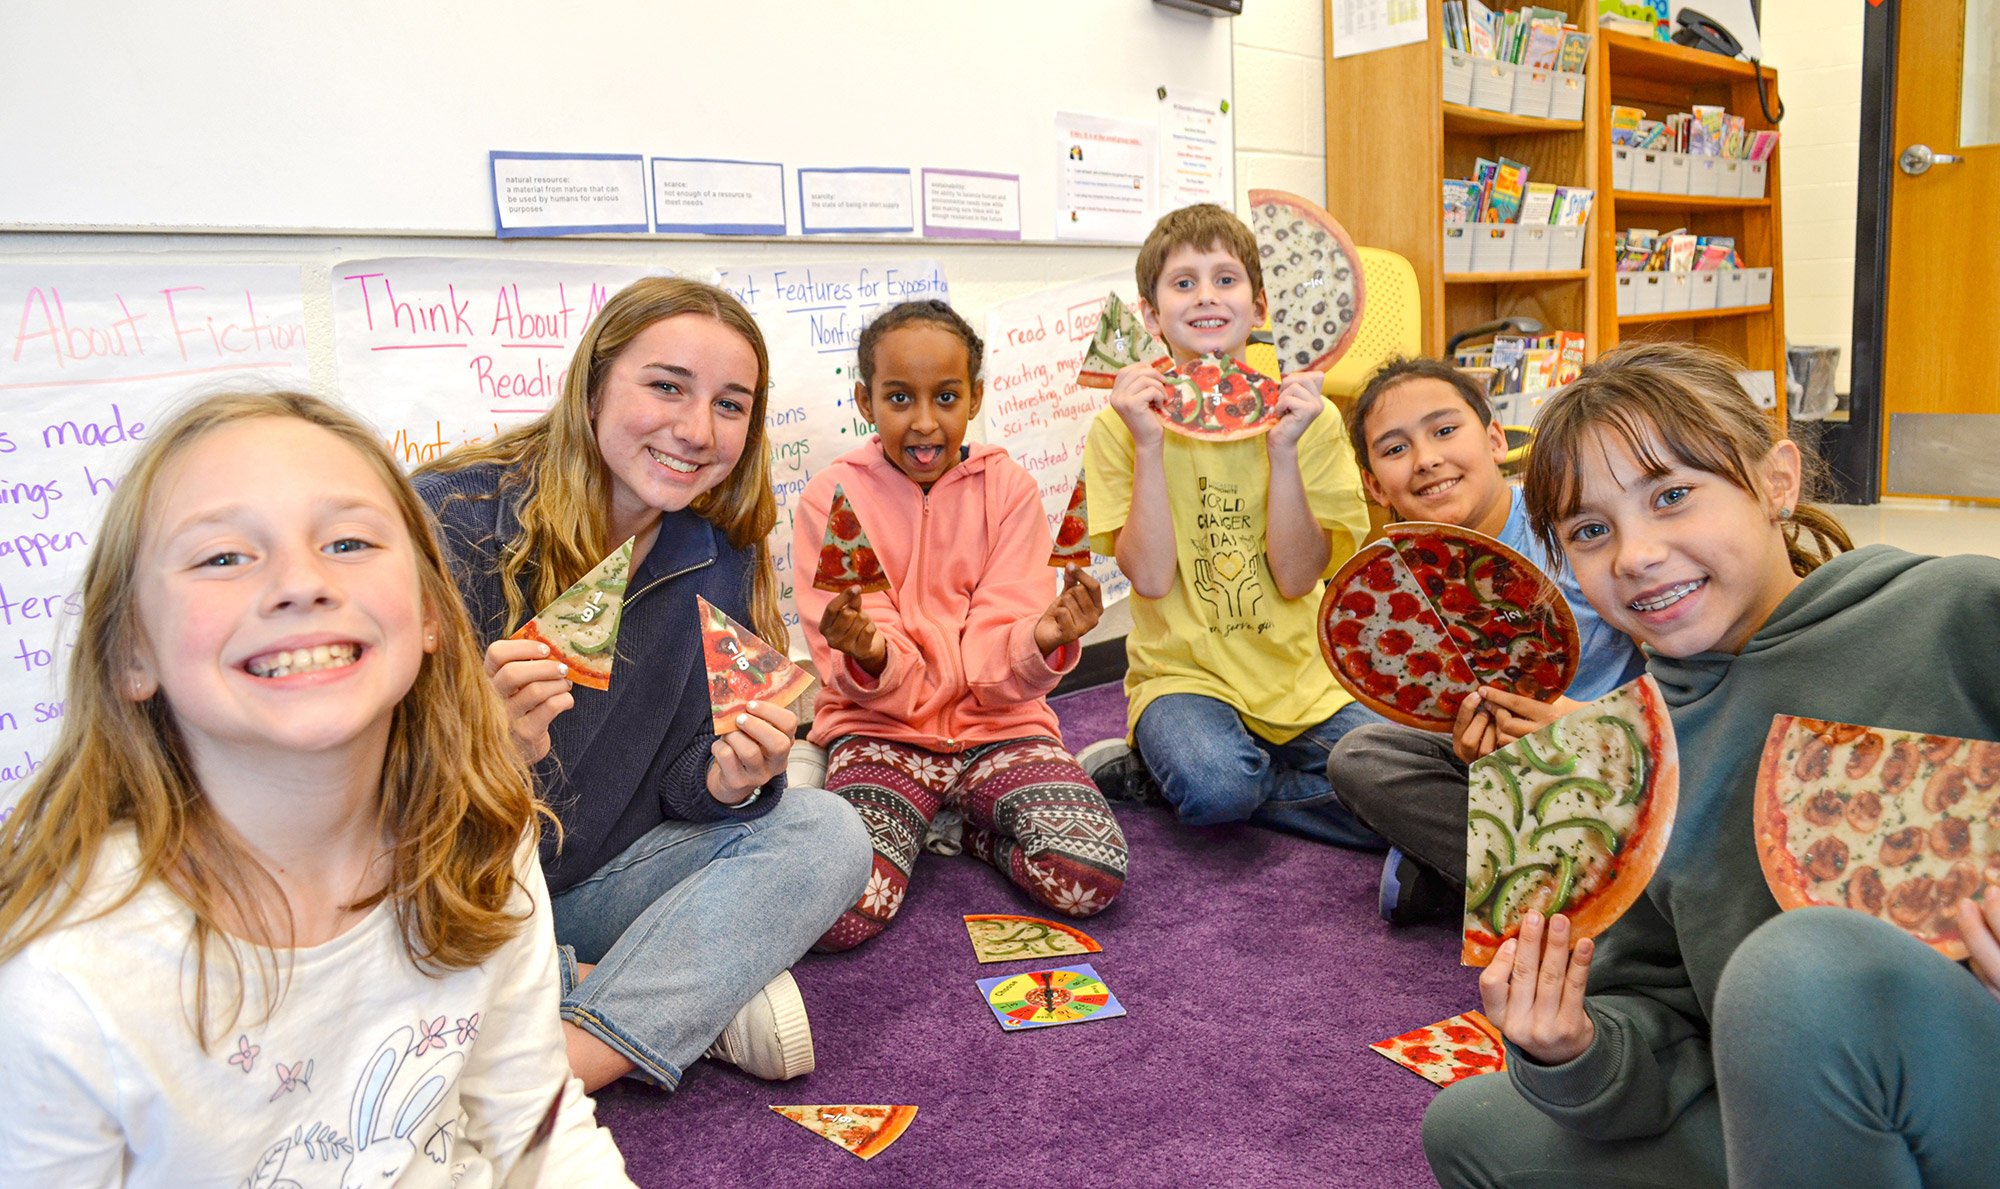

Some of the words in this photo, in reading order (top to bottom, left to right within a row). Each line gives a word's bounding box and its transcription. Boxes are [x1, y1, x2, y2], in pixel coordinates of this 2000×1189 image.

[505, 176, 532, 184] natural
[534, 176, 570, 184] resource:
[513, 185, 543, 193] material
[546, 185, 562, 193] from
[564, 185, 588, 193] nature
[589, 185, 604, 193] that
[676, 190, 702, 199] enough
[508, 195, 517, 203] be
[519, 195, 538, 203] used
[539, 194, 549, 204] by
[550, 194, 579, 202] humans
[580, 194, 591, 202] for
[592, 194, 620, 202] various
[508, 205, 543, 214] purposes
[774, 268, 853, 302] Features
[857, 267, 880, 298] for
[344, 272, 473, 337] Think
[491, 282, 575, 340] About
[12, 286, 148, 368] About
[159, 285, 307, 363] Fiction
[1006, 314, 1046, 347] read
[1055, 319, 1065, 334] a
[993, 362, 1054, 391] exciting,
[998, 389, 1062, 417] interesting,
[1003, 411, 1048, 438] sci-fi,
[1052, 395, 1102, 420] magical,
[42, 403, 151, 449] made
[1017, 442, 1069, 471] Instead
[1075, 435, 1087, 456] of
[14, 638, 52, 672] to
